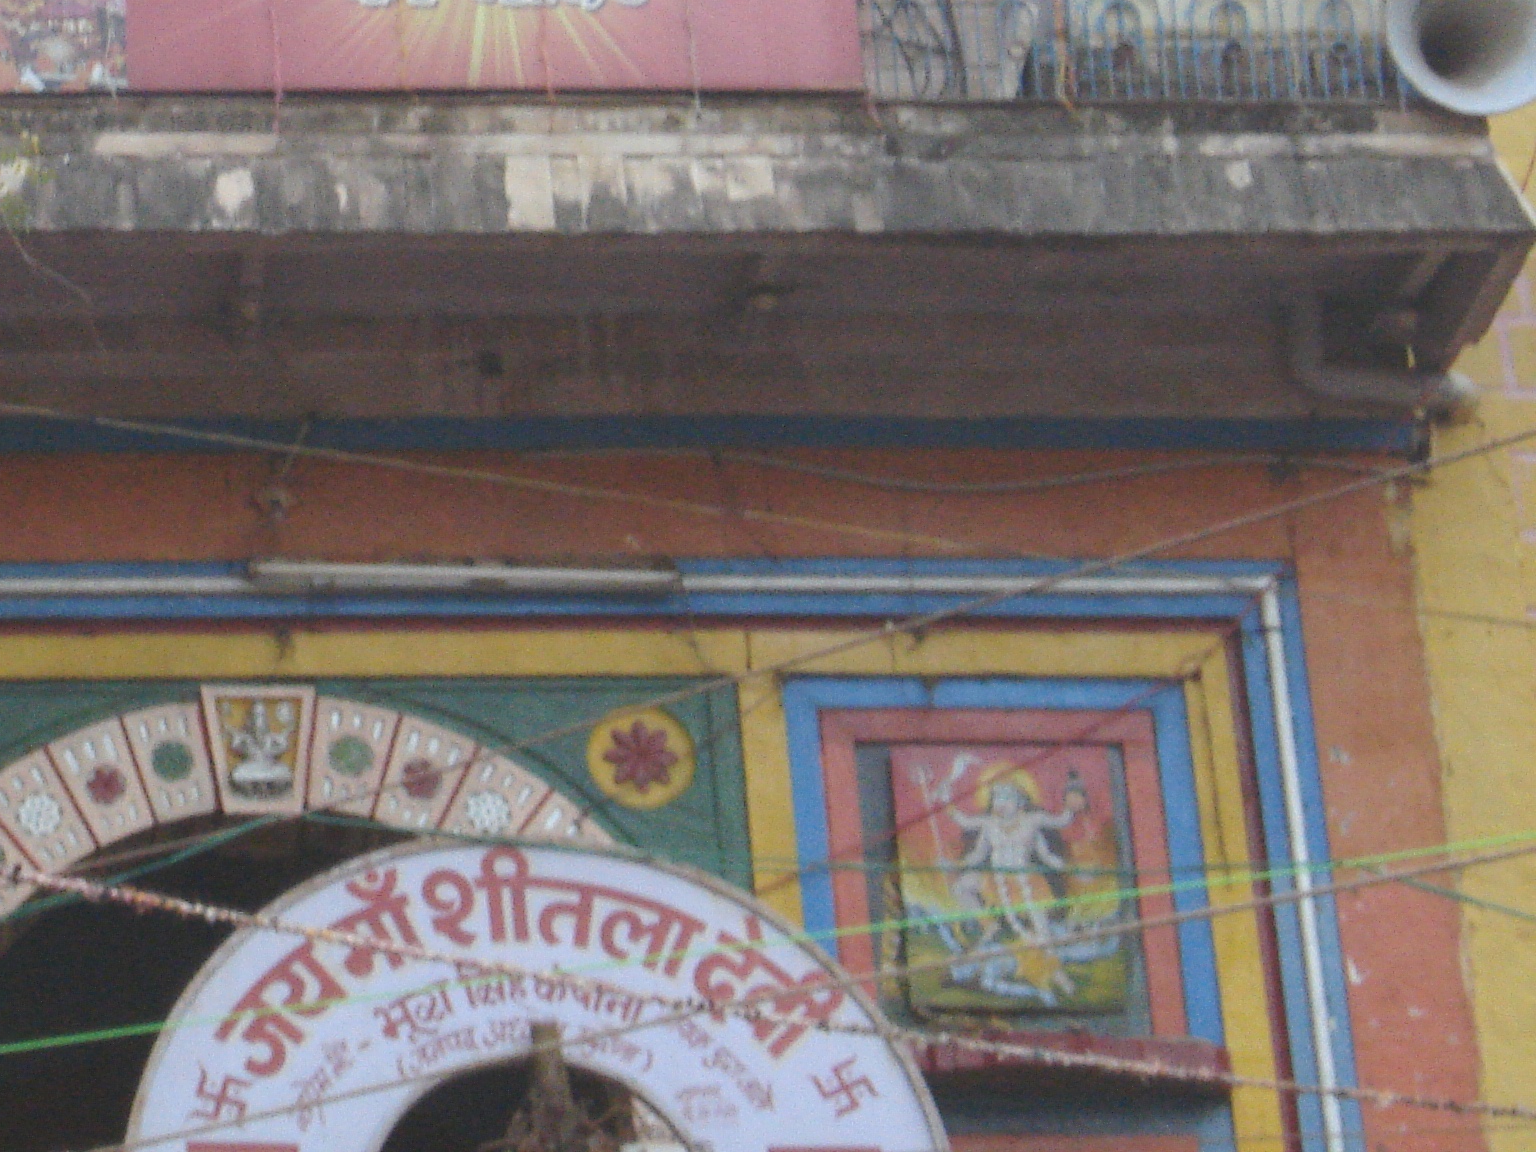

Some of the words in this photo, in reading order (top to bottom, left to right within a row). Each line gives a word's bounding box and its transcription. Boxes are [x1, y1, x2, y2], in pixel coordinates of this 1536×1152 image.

[214, 934, 348, 1084] जय
[332, 865, 423, 983] माँ
[421, 845, 707, 978] शीतला
[690, 914, 854, 1060] देवी
